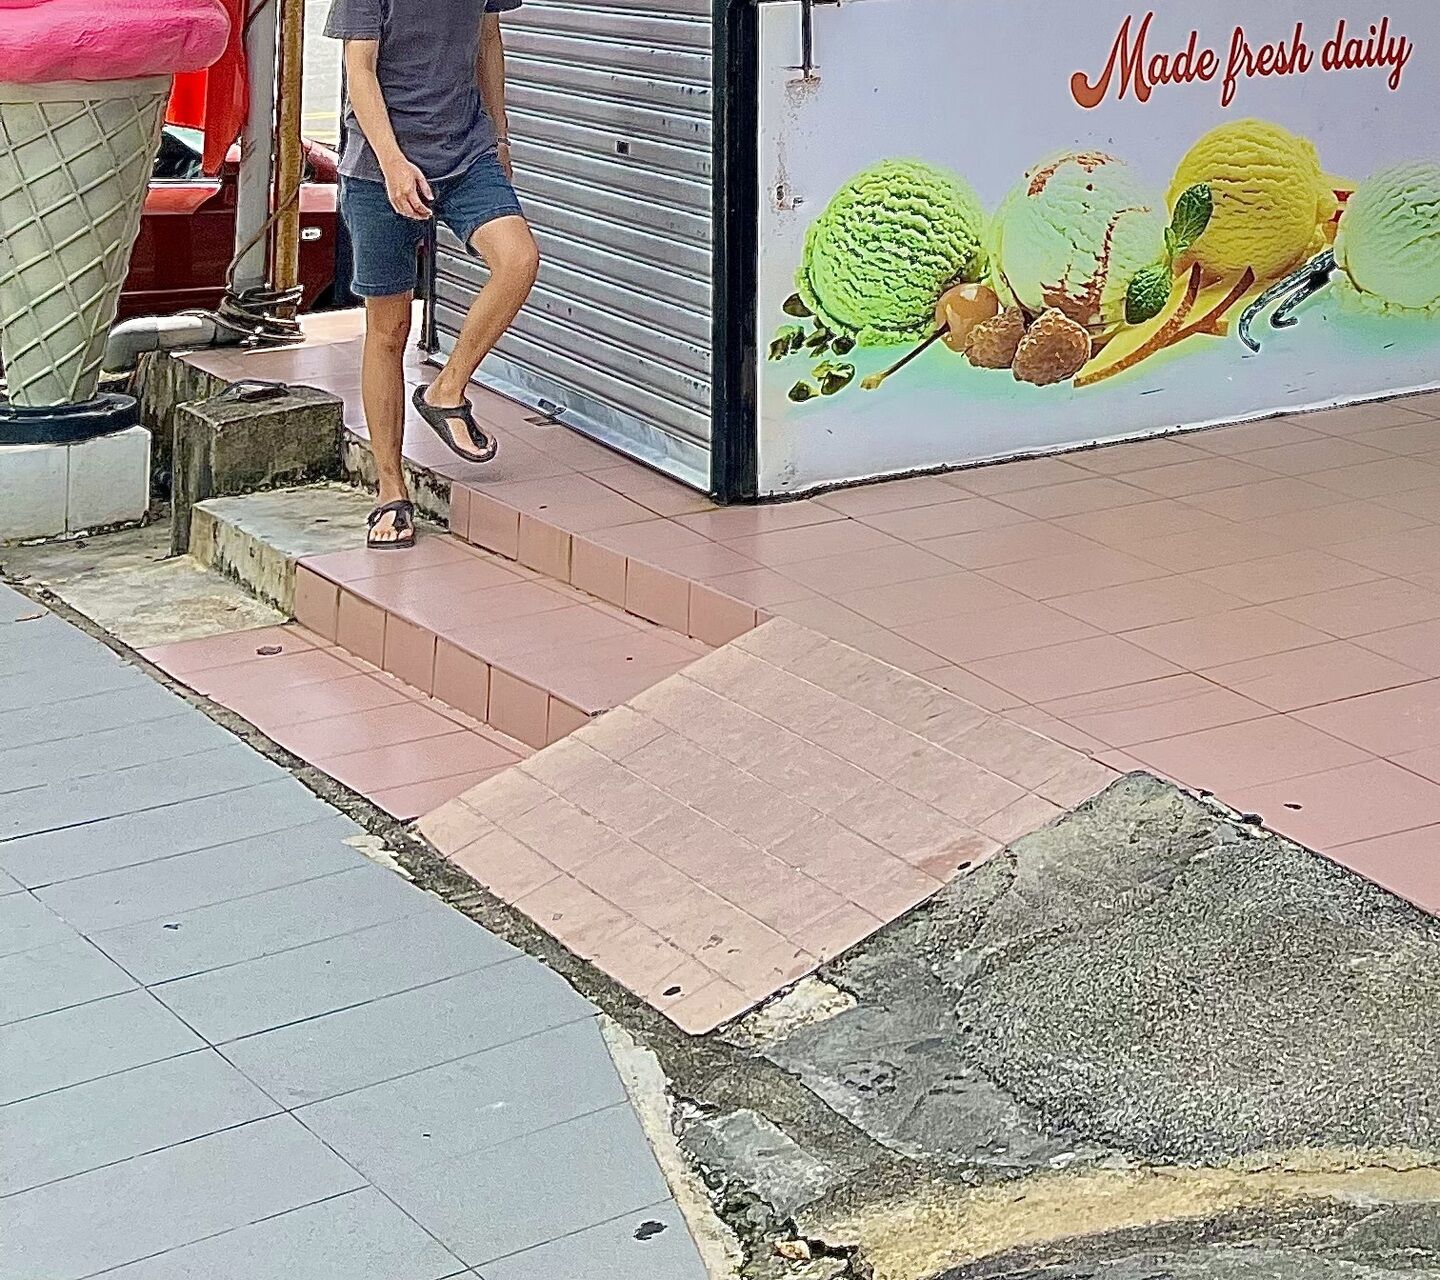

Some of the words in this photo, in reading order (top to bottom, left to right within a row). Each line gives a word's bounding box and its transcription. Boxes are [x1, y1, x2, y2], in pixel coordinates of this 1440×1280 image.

[1069, 12, 1219, 109] Made
[1219, 22, 1313, 107] fresh
[1321, 15, 1414, 91] daily
